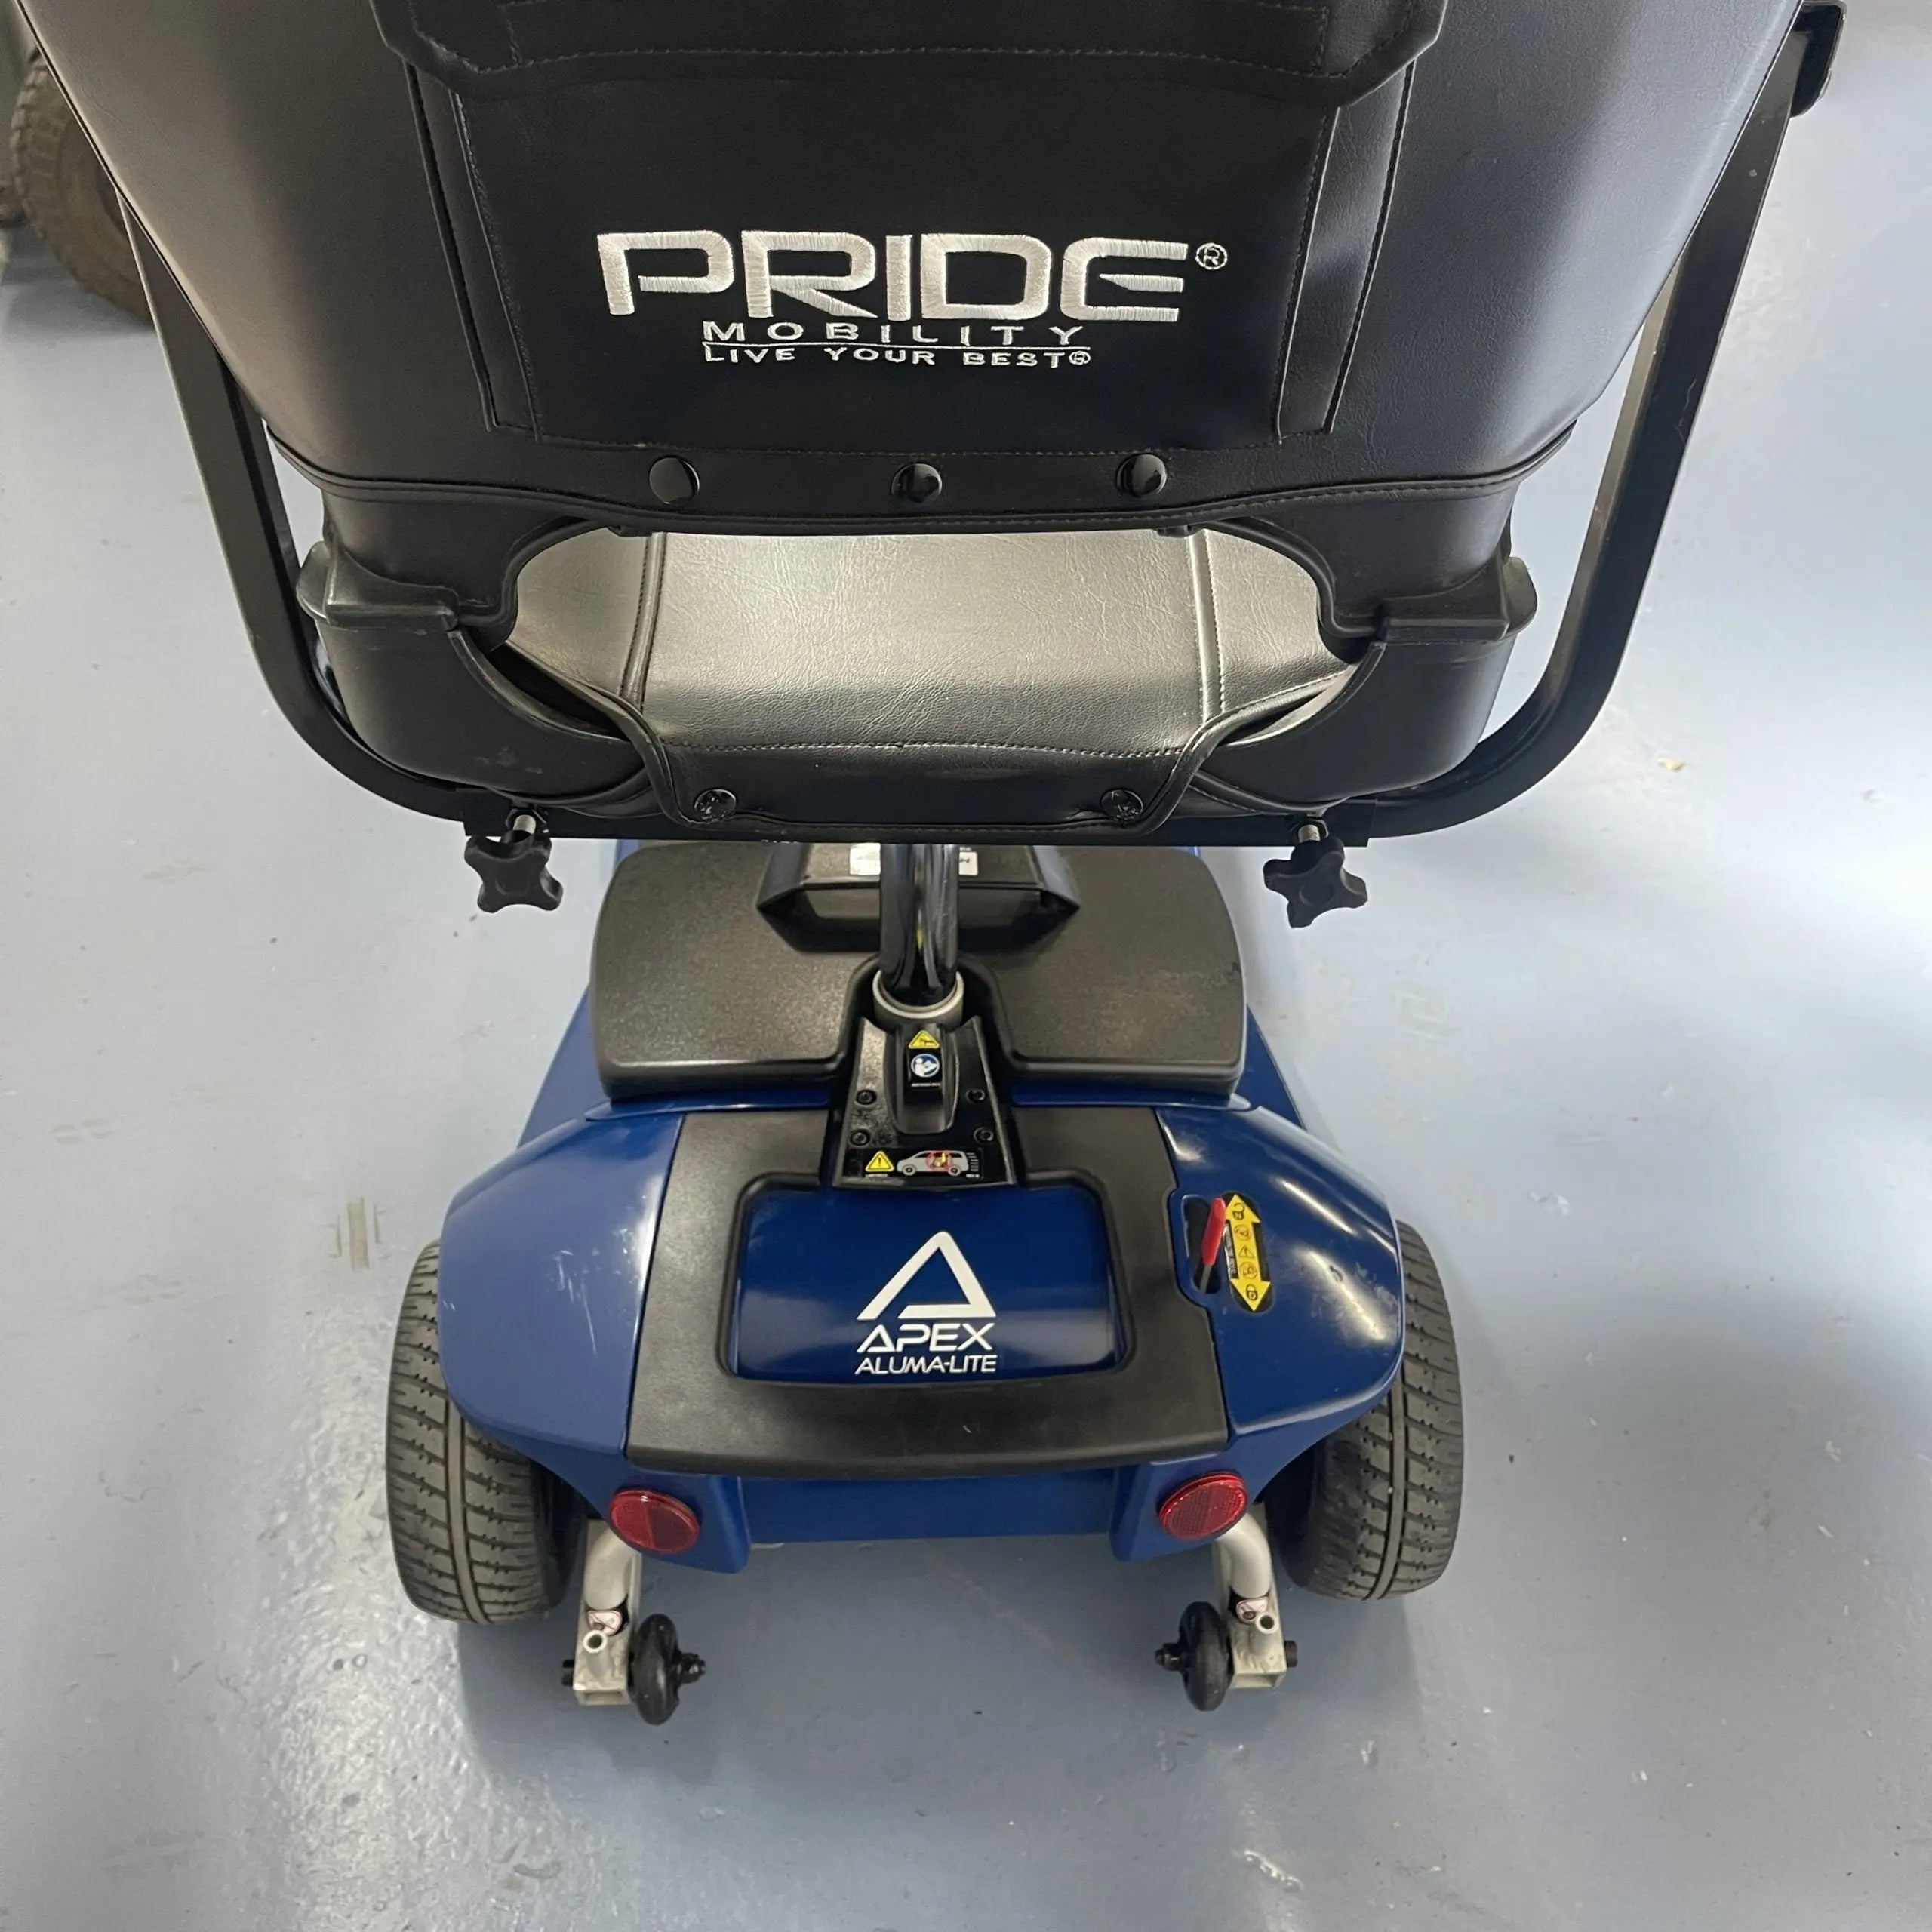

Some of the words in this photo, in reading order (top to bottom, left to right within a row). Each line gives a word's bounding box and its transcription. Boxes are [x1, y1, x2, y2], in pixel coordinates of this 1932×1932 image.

[703, 321, 1083, 346] MOBILITY
[703, 343, 795, 363] LIVE
[824, 347, 936, 365] YOUR
[857, 1323, 995, 1353] APEX
[854, 1355, 998, 1375] ALUMA-LITE
